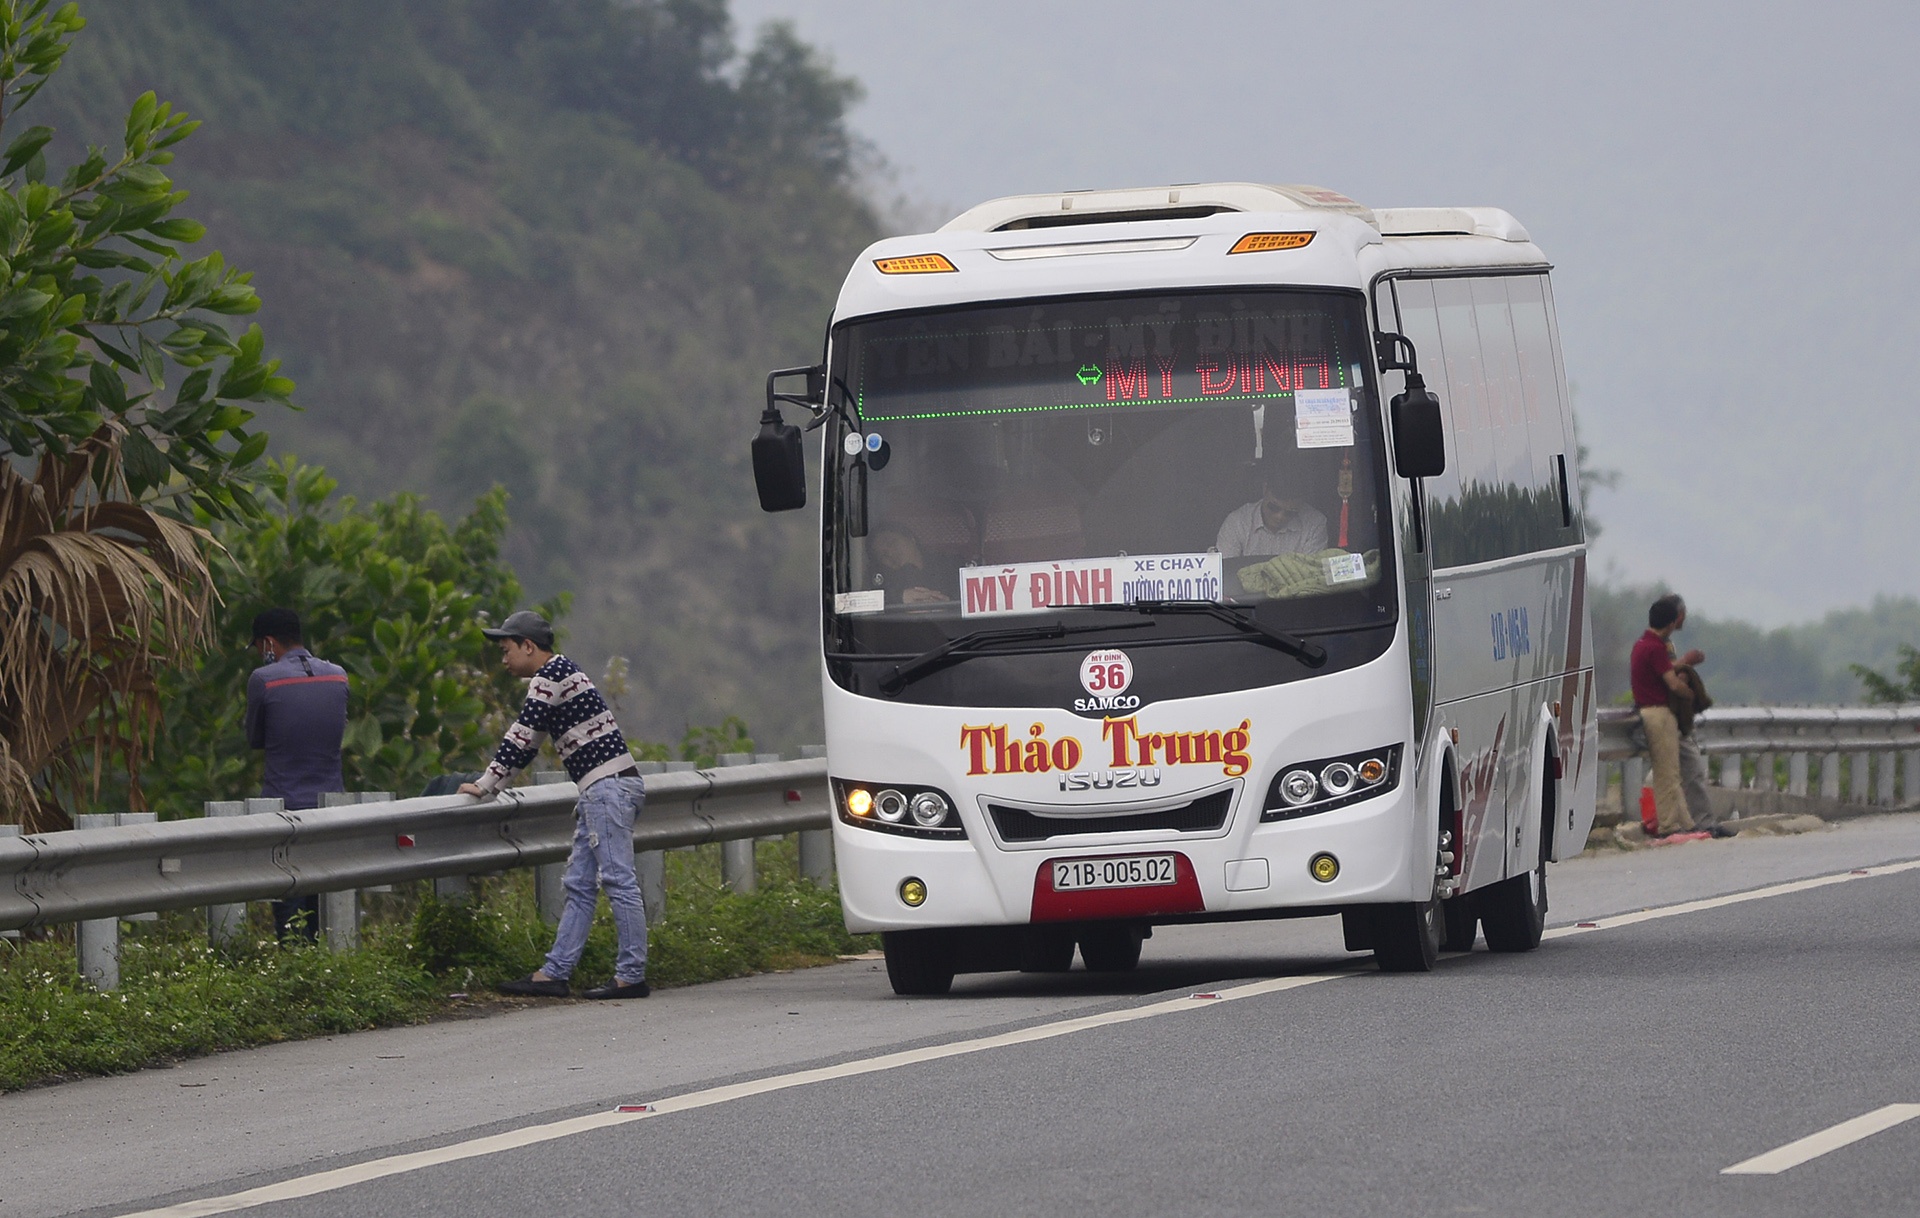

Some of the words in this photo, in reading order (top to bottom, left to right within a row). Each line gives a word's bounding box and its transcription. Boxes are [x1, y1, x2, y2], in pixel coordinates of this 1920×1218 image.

[1134, 560, 1155, 572] XE
[1160, 557, 1206, 572] CHẠY
[965, 567, 1018, 614] MỸ
[1029, 563, 1113, 609] ĐÌNH
[1122, 574, 1165, 605] ĐƯỜNG
[1168, 578, 1192, 601] CAO
[1195, 571, 1219, 601] TỐC
[1089, 663, 1125, 691] 36
[1074, 695, 1140, 711] SAMCO
[960, 721, 1083, 776] Thảo
[1102, 714, 1252, 777] Trung
[1058, 768, 1161, 792] ISUZU
[1057, 858, 1172, 887] 21B-005.02
